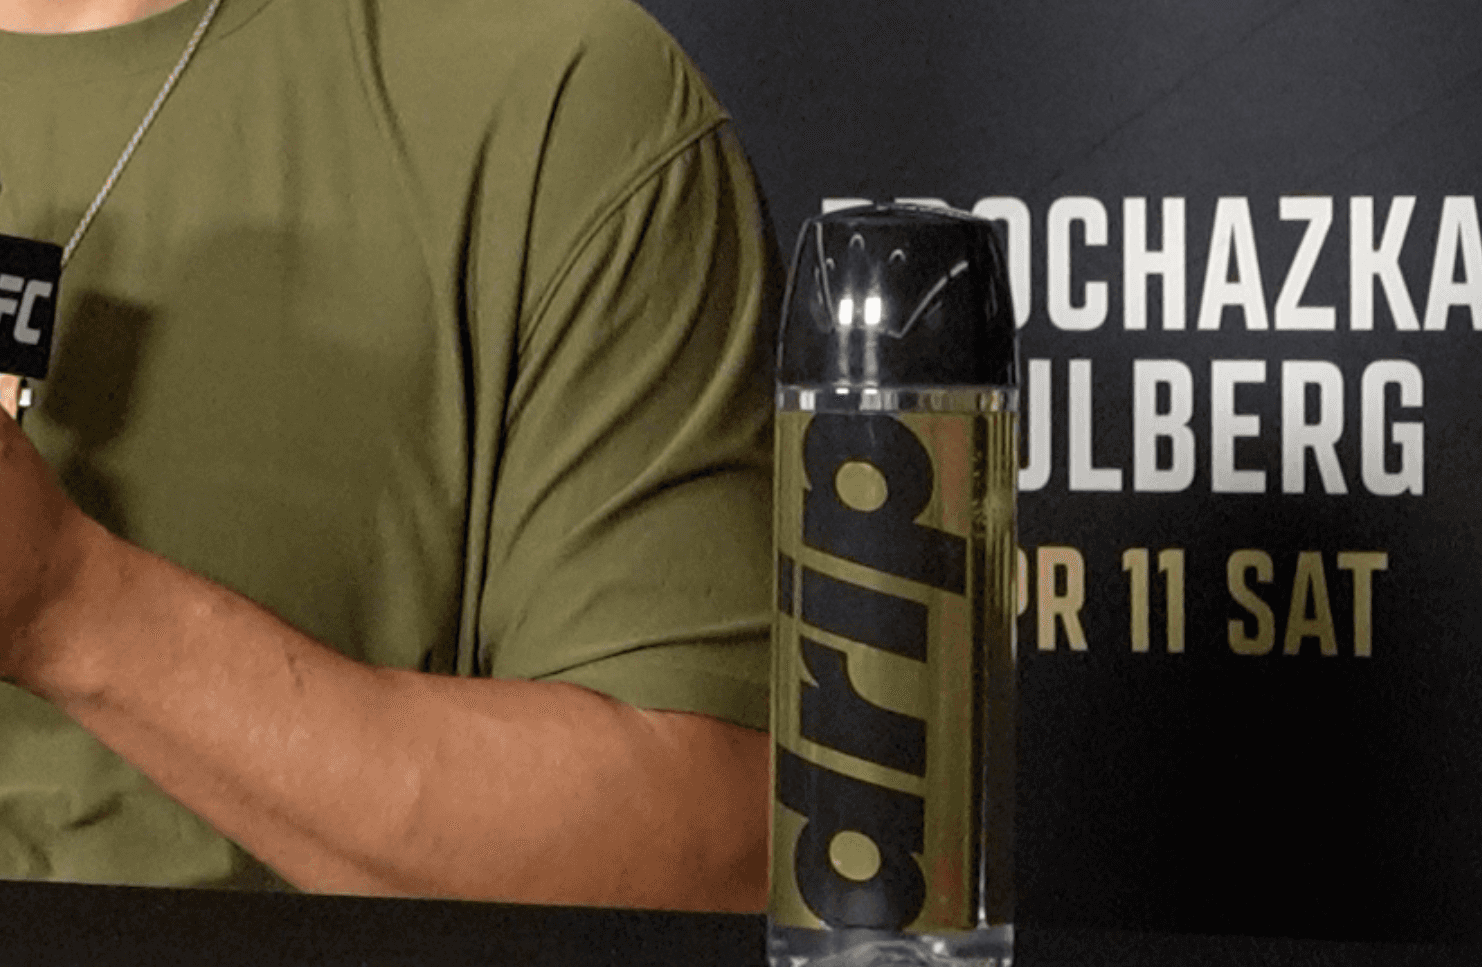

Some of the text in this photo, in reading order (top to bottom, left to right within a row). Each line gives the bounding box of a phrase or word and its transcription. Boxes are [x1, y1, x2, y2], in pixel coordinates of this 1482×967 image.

[822, 196, 1482, 331] OCHAZKA
[1122, 548, 1185, 652] 11
[1227, 549, 1388, 657] SAT
[776, 412, 969, 930] drip
